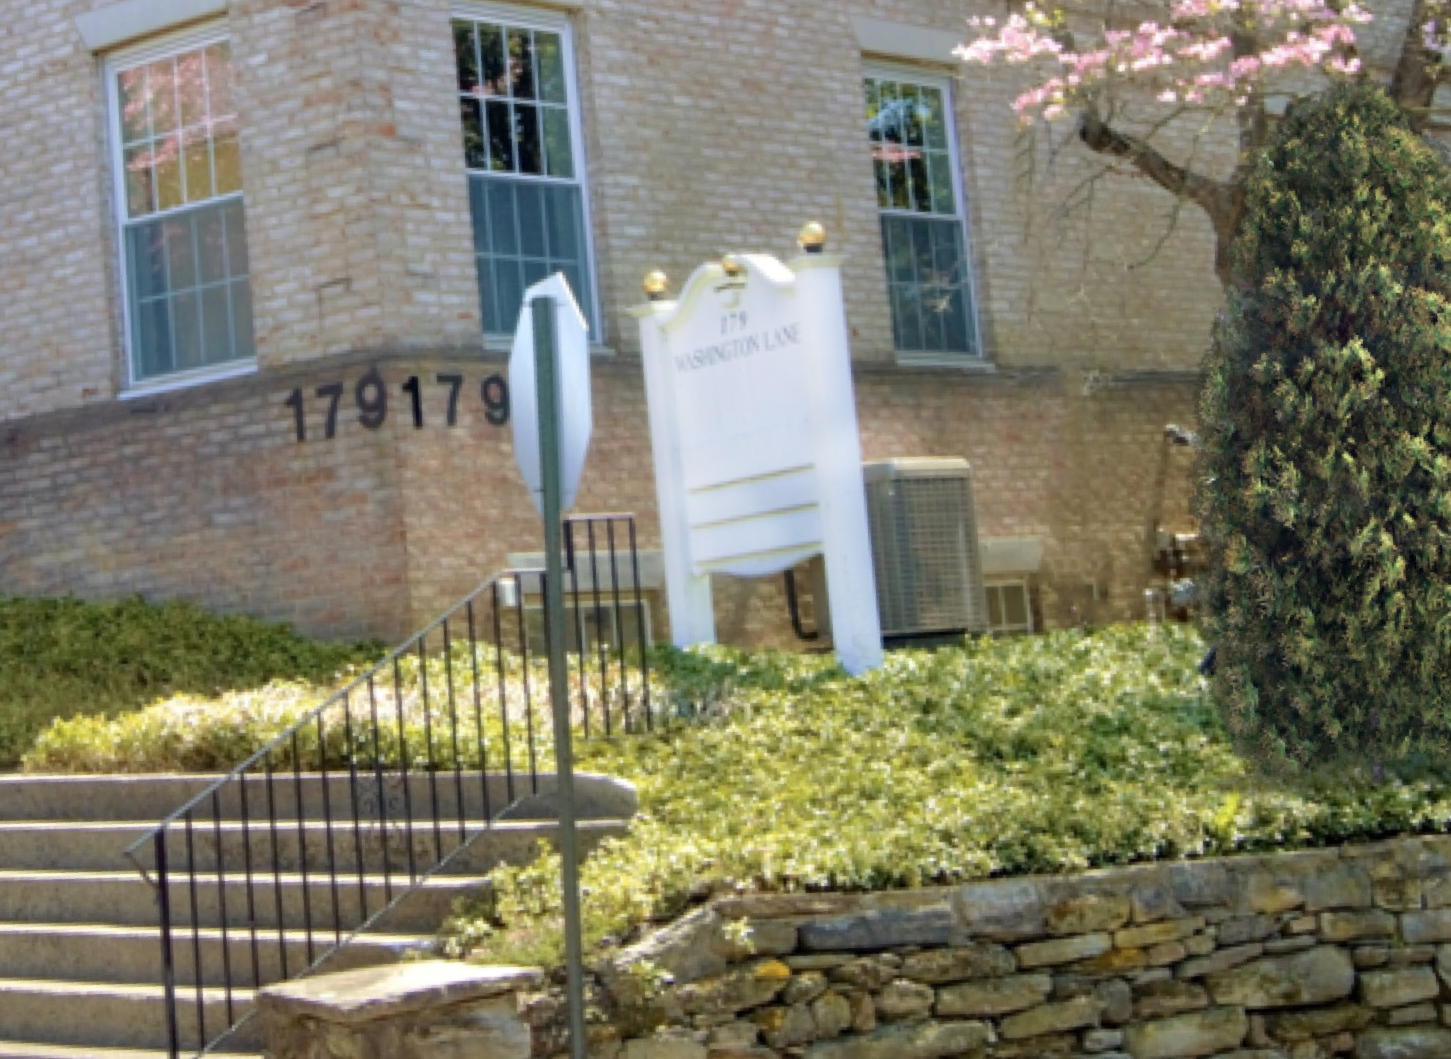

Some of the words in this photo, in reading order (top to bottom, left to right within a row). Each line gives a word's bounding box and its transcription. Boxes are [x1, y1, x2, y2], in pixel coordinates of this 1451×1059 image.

[674, 332, 759, 373] WASHINGTON
[762, 322, 801, 352] LANE
[719, 310, 747, 335] 179
[284, 371, 388, 442] 179
[402, 373, 511, 429] 179
